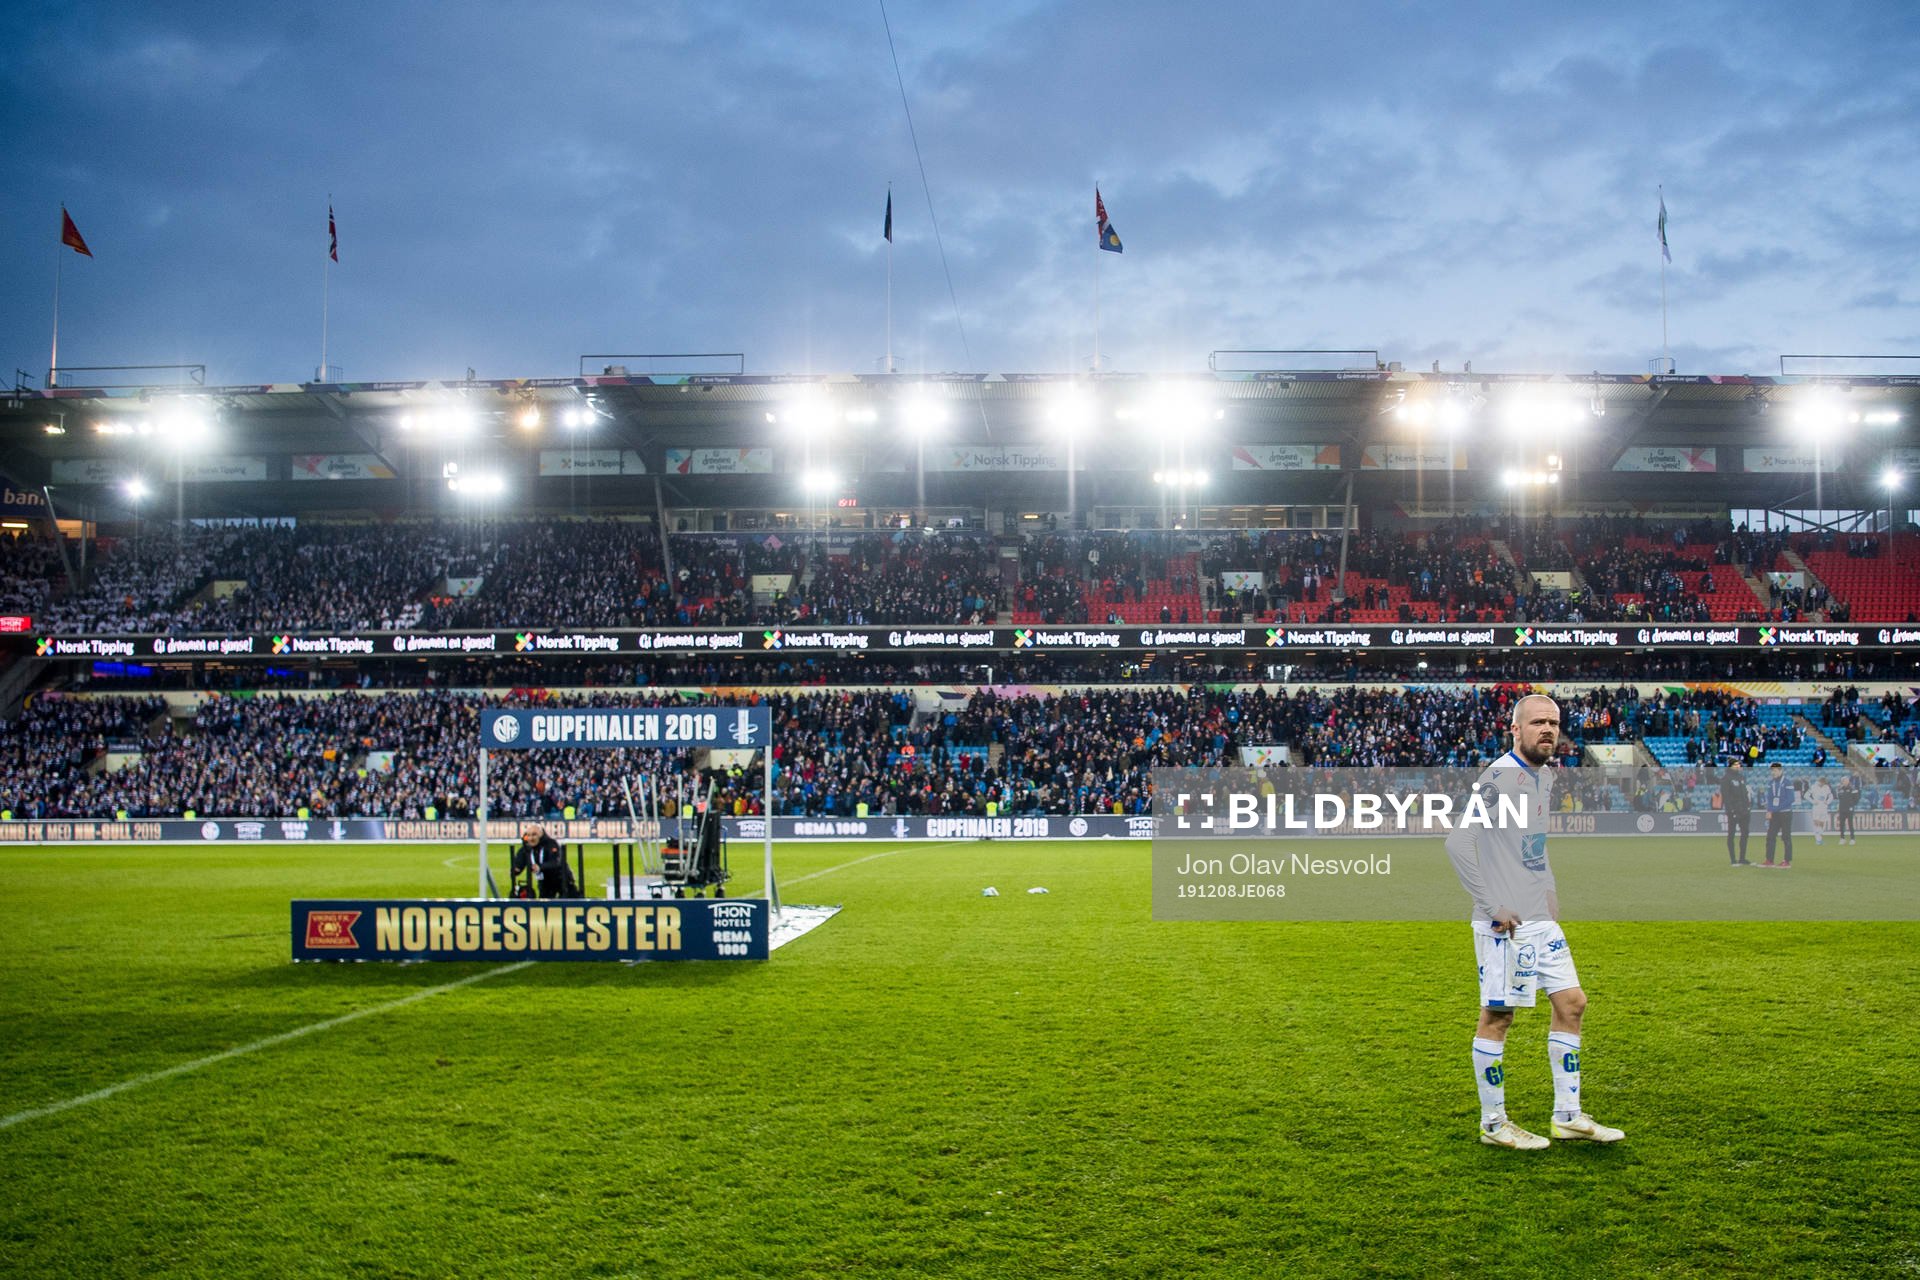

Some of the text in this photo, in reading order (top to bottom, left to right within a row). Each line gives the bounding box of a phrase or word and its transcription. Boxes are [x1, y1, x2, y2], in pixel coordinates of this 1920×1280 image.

[974, 454, 1056, 468] Norsk Tipping
[393, 636, 405, 651] Gi
[449, 638, 460, 648] en
[462, 634, 495, 652] sjanse!
[536, 635, 618, 651] Norsk Tipping
[639, 634, 651, 649] Gi
[695, 636, 707, 647] en
[709, 633, 743, 649] sjanse!
[785, 633, 868, 648] Norsk Tipping
[889, 632, 901, 646] Gi
[946, 634, 958, 644] en
[960, 631, 994, 647] sjanse!
[1036, 632, 1120, 647] Norsk Tipping
[1141, 631, 1152, 645] Gi
[1198, 633, 1209, 643] en
[1211, 630, 1245, 647] sjanse!
[1288, 631, 1370, 646] Norsk Tipping
[1391, 630, 1403, 644] Gi
[1448, 632, 1459, 642] en
[1461, 629, 1494, 646] sjanse!
[1536, 630, 1618, 645] Norsk Tipping
[1638, 630, 1650, 643] Gi
[1693, 632, 1705, 641] en
[1707, 629, 1739, 645] sjanse!
[1780, 630, 1859, 645] Norsk Tipping
[1879, 629, 1890, 643] Gi
[56, 640, 134, 656] Norsk Tipping
[154, 638, 165, 653] Gi
[207, 641, 219, 652] en
[221, 638, 253, 654] sjanse!
[292, 638, 373, 653] Norsk Tipping
[532, 715, 659, 742] CUPFINALEN
[665, 714, 717, 740] 2019
[794, 822, 867, 835] REMA 1000
[926, 818, 1049, 836] CUPFINALEN 2019
[1125, 817, 1163, 829] THON
[1566, 815, 1595, 832] 2019
[1670, 815, 1700, 826] THON
[28, 824, 43, 840] FK
[47, 824, 72, 840] MED
[74, 824, 132, 840] NM-GULL
[134, 823, 162, 840] 2019
[384, 822, 396, 839] VI
[398, 822, 468, 839] GRATULERER
[473, 822, 518, 838] VKING
[568, 820, 628, 838] NM-GULL
[709, 902, 756, 918] THON
[376, 906, 682, 952] NORGESMESTER
[714, 919, 751, 927] HOTELS
[713, 931, 752, 943] REMA
[718, 944, 748, 956] 1000
